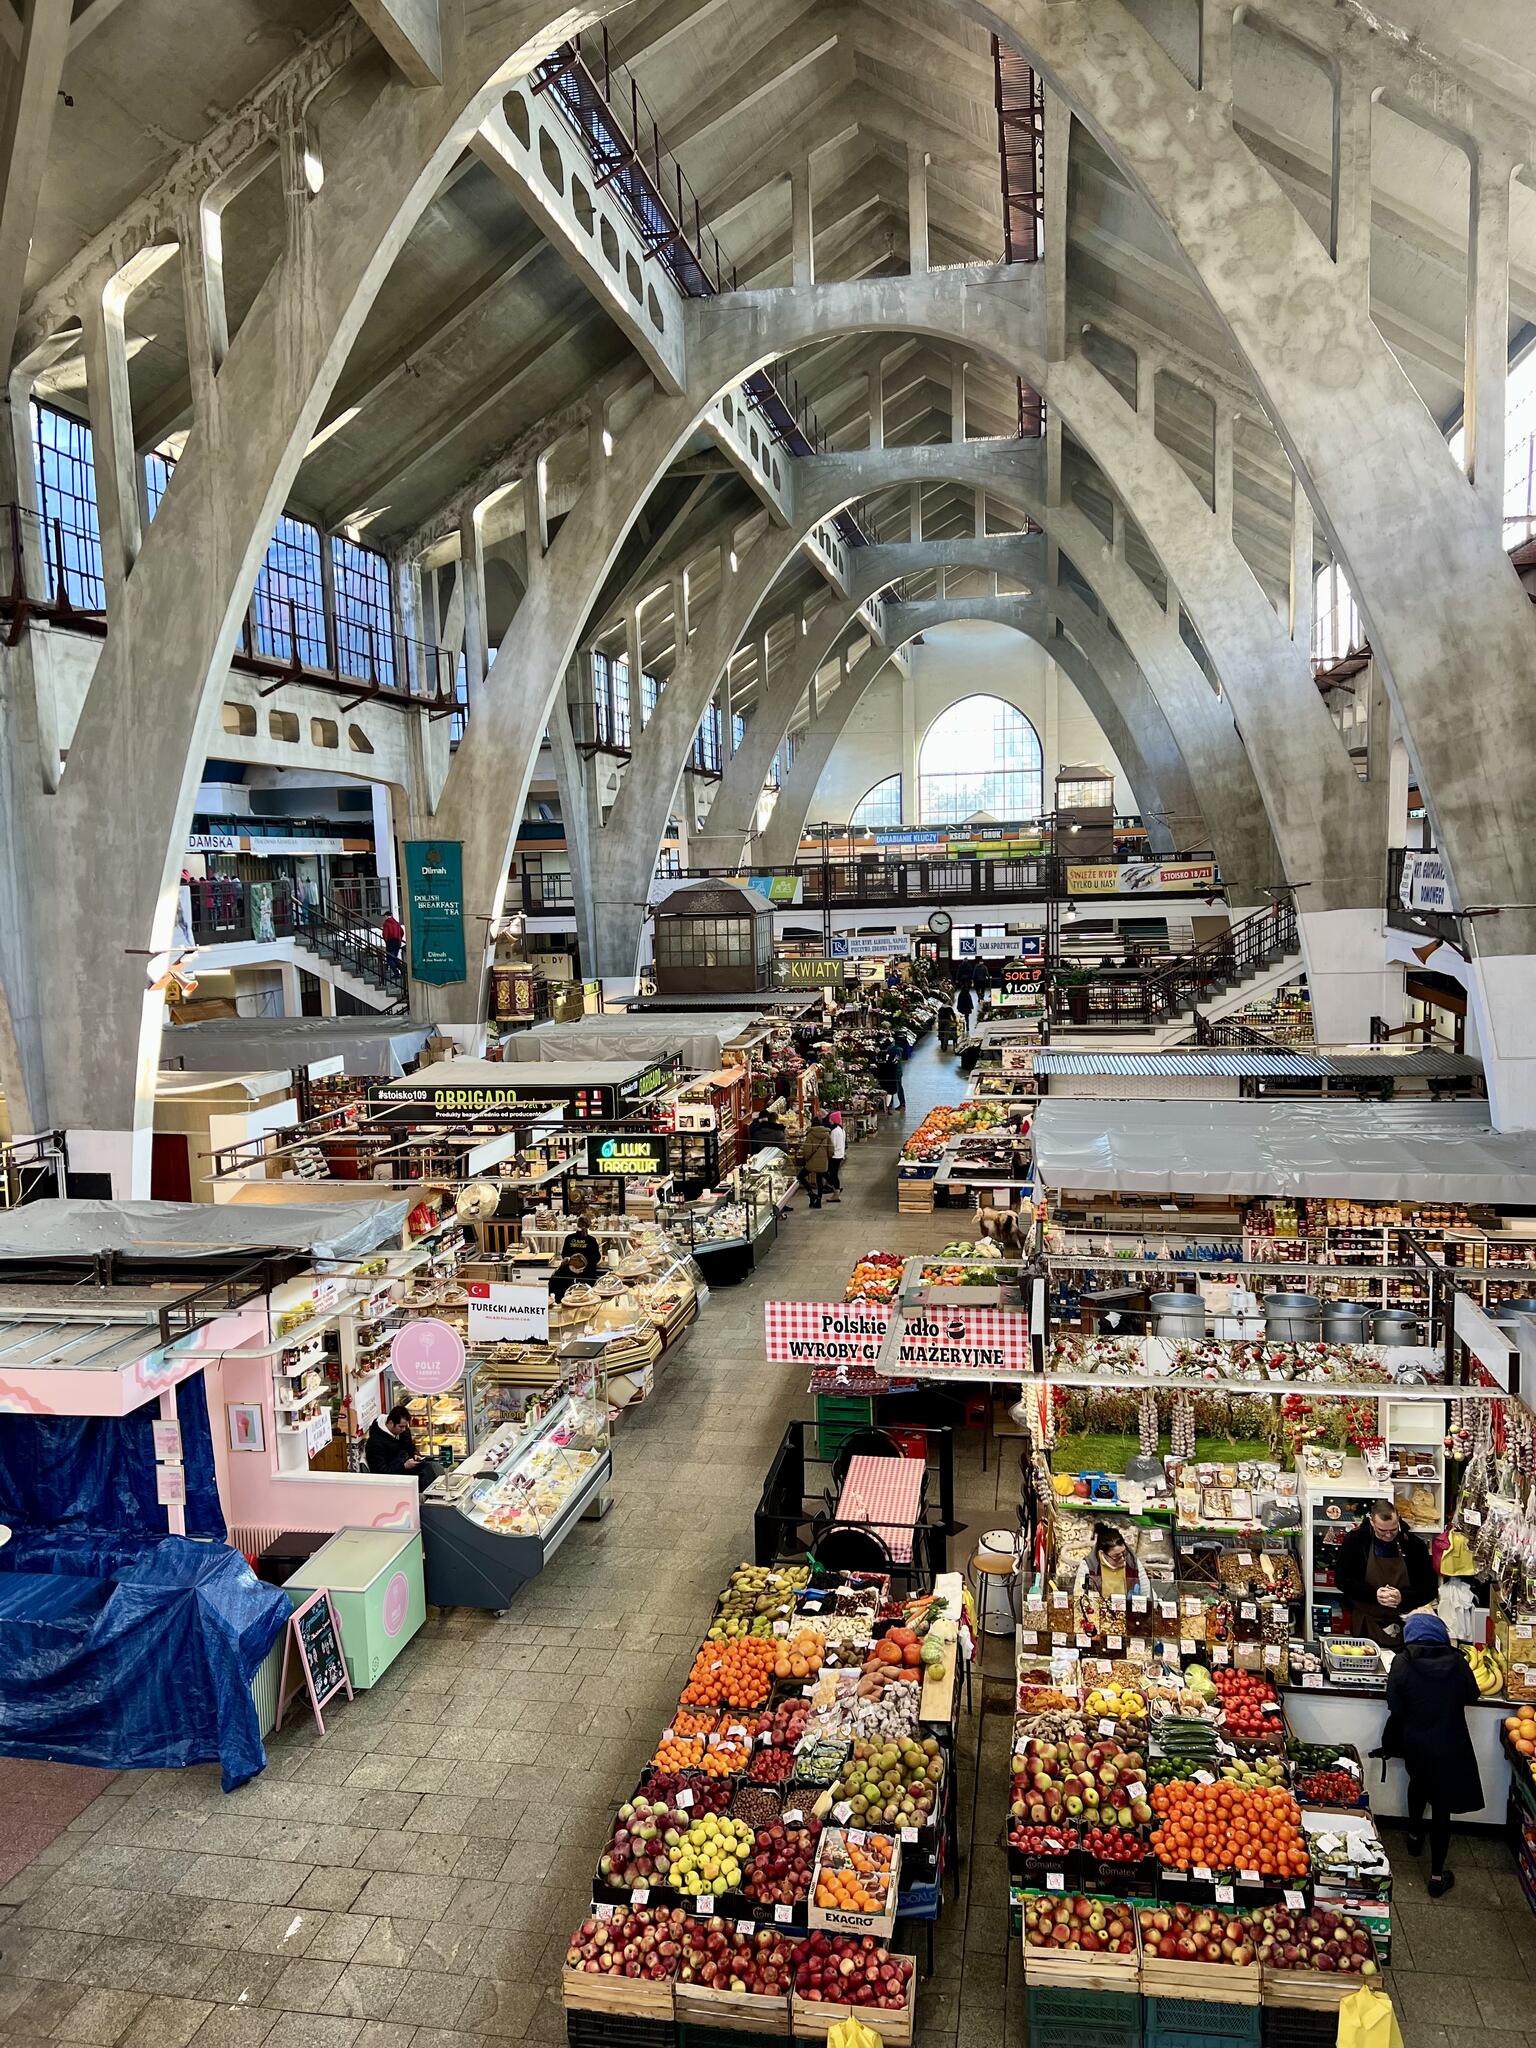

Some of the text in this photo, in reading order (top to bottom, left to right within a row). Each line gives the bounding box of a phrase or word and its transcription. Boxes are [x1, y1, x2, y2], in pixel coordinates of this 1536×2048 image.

[876, 833, 937, 844] DORABIANIE KLUCZY
[950, 832, 971, 840] KSERO
[983, 831, 1001, 839] DRUK
[189, 835, 233, 848] DAMSKA
[422, 866, 447, 875] Dilmah
[1070, 869, 1118, 879] ŚWIEŻE RYBY
[1164, 868, 1210, 880] STOISKO 18/21
[1073, 879, 1116, 889] TYLKO U NAS!
[444, 908, 459, 916] TEA
[791, 961, 839, 977] KWIATY
[1004, 971, 1030, 981] SOKI
[1014, 983, 1040, 993] LODY
[378, 1089, 427, 1101] #stoisko109
[434, 1089, 517, 1110] OBRIGADO
[435, 1111, 461, 1119] Produkty
[597, 1159, 659, 1173] TARGOWA
[471, 1302, 546, 1316] TURECKI MARKET
[821, 1314, 940, 1337] Polskie adło
[789, 1341, 1004, 1367] WYROBY GAMAŻERYJNE
[825, 1912, 874, 1927] EXAGRO
